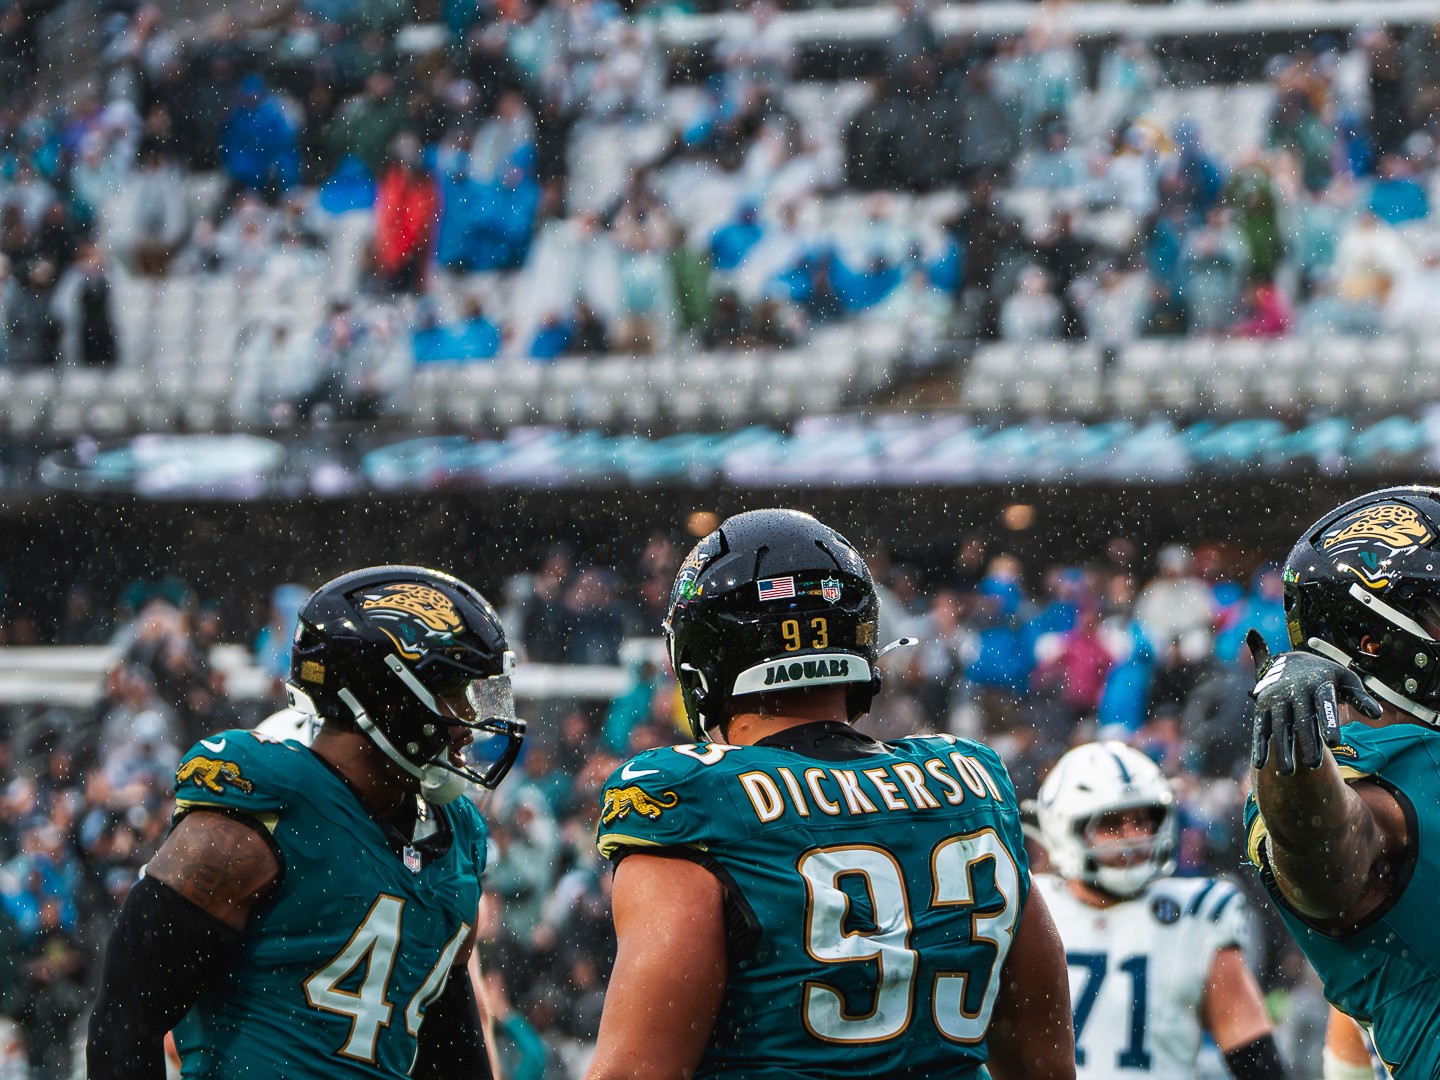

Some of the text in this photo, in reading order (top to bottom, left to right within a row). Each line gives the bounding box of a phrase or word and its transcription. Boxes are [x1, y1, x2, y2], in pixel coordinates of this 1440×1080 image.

[824, 588, 839, 599] NFL
[781, 617, 829, 651] 93
[764, 659, 849, 686] JAGUARS
[798, 828, 1020, 1045] 93
[1066, 951, 1153, 1070] 71
